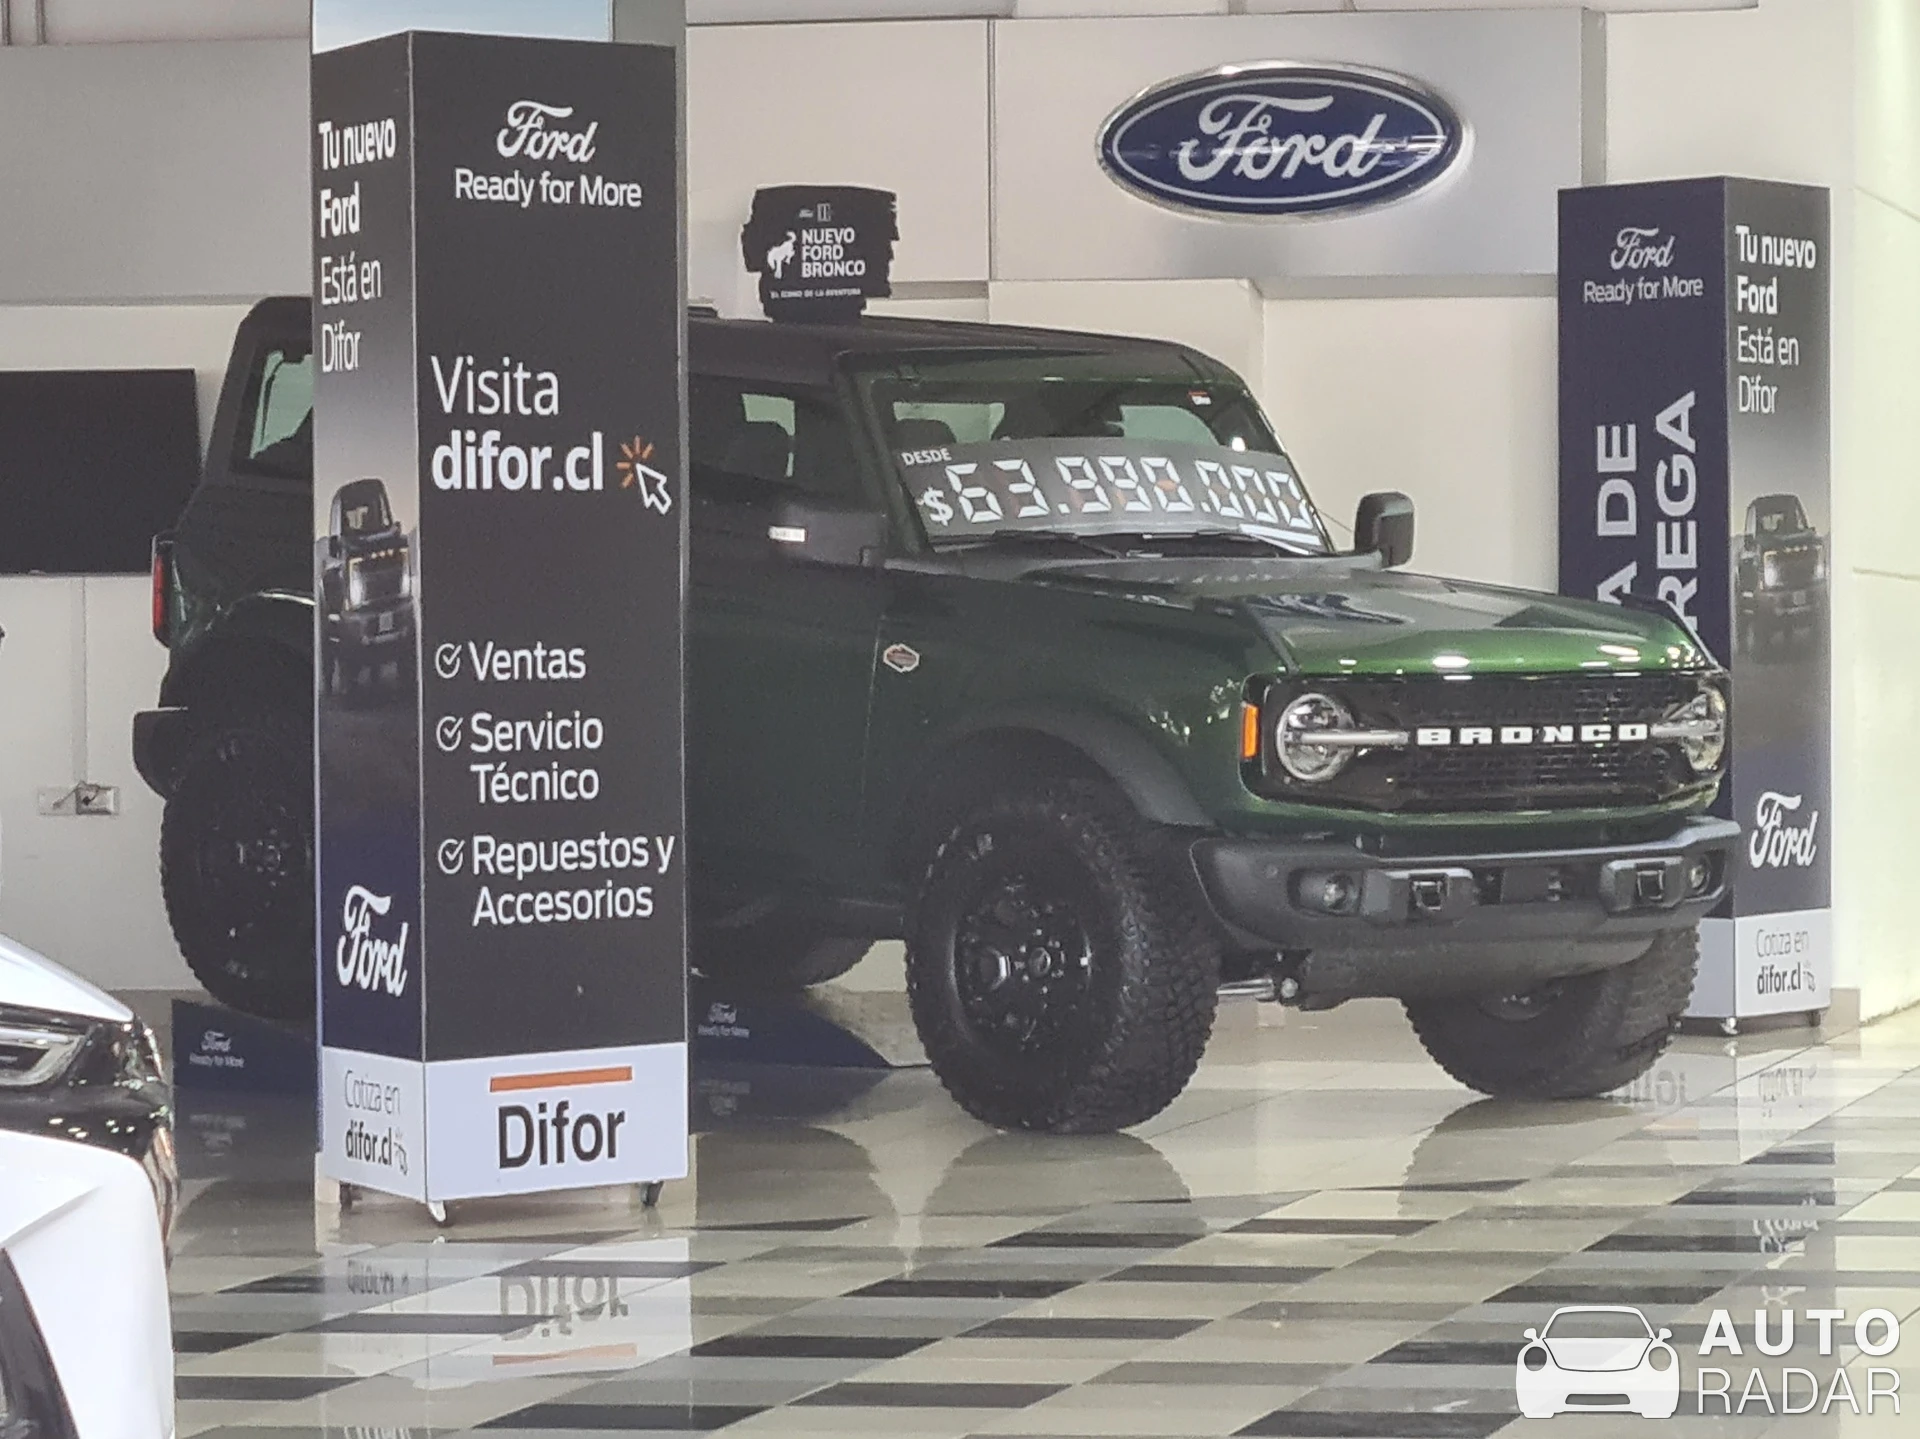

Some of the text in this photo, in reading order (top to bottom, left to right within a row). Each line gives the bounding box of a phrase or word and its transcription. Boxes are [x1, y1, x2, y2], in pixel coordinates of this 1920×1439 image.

[318, 118, 396, 170] Tu nuevo
[497, 100, 599, 163] Ford
[1178, 94, 1387, 181] Ford
[320, 180, 360, 238] Ford
[455, 168, 642, 208] Ready for More
[802, 227, 855, 245] NUEVO
[802, 244, 844, 261] FORD
[1611, 227, 1676, 270] Ford
[1735, 225, 1816, 269] Tu nuevo
[320, 250, 382, 305] Está en
[802, 260, 866, 278] BRONCO
[1584, 275, 1703, 305] Ready for More
[1737, 276, 1778, 315] Ford
[322, 319, 361, 373] Difor
[1738, 325, 1799, 366] Está en
[430, 355, 559, 416] Visita
[1739, 375, 1778, 414] Difor
[432, 430, 604, 491] difor.cl
[902, 448, 952, 467] DESDE
[1597, 423, 1637, 536] DE
[468, 641, 587, 681] Ventas
[470, 712, 604, 754] Servicio
[1417, 724, 1648, 746] BRONCO
[471, 762, 600, 803] Técnico
[1750, 792, 1818, 868] Ford
[473, 831, 675, 880] Repuestos y
[473, 880, 654, 926] Accesorios
[337, 885, 408, 997] Ford
[1756, 929, 1809, 957] Cotiza en
[1757, 962, 1801, 994] difor.cl
[345, 1069, 401, 1114] Cotiza en
[346, 1119, 393, 1166] difor.cl
[498, 1100, 625, 1170] Difor
